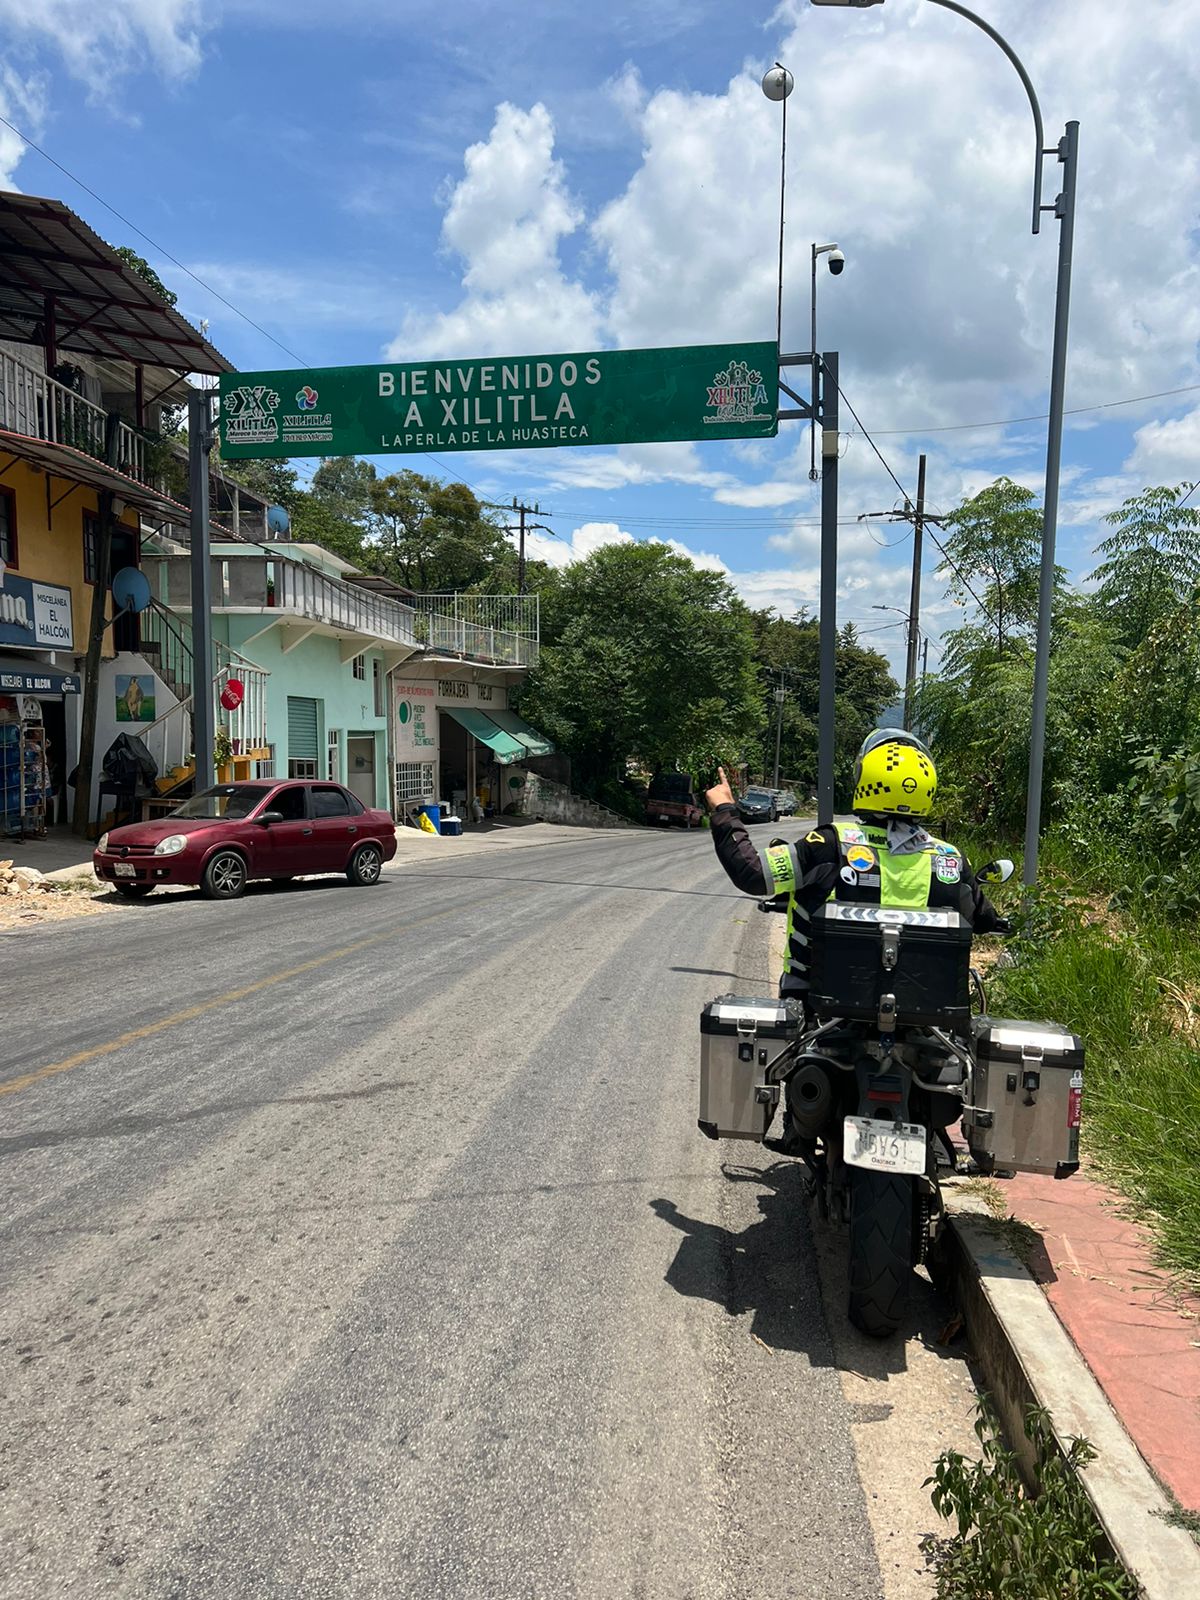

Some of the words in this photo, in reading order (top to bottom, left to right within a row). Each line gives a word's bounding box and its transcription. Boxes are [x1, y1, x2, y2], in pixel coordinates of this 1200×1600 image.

[378, 358, 602, 397] BIENVENIDOS
[706, 384, 768, 406] XILITLA
[403, 400, 424, 428] A
[440, 392, 576, 427] XILITLA
[227, 418, 277, 431] XILITLA
[283, 414, 332, 426] XILITLA
[462, 430, 480, 444] DE
[487, 428, 505, 442] LA
[512, 425, 589, 441] HUASTECA
[37, 593, 67, 607] MISCELÁNEA
[49, 609, 58, 622] EL
[39, 624, 70, 639] HALCÓN
[26, 678, 33, 688] EL
[438, 680, 469, 699] FORRAJERA
